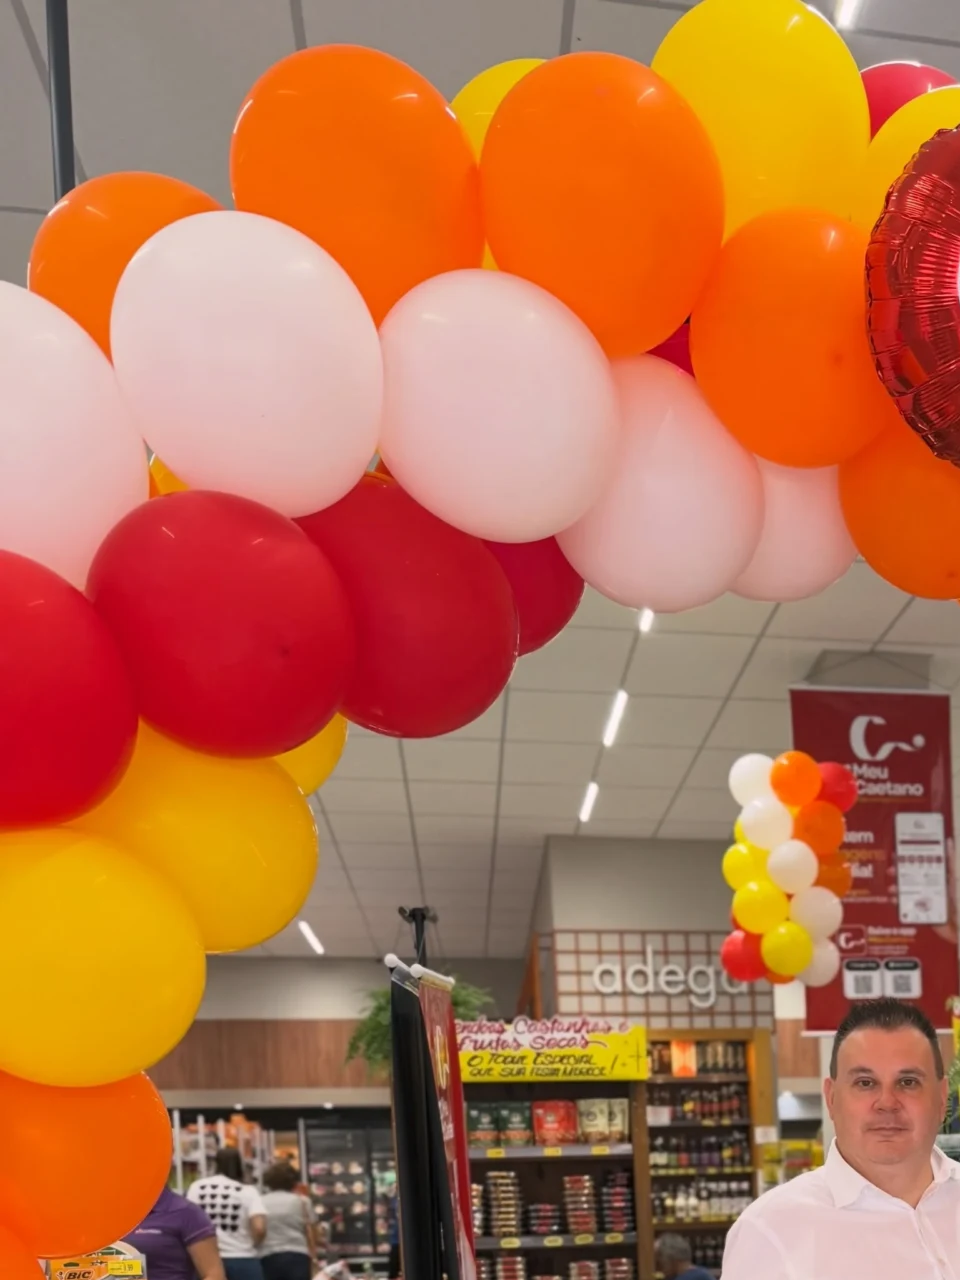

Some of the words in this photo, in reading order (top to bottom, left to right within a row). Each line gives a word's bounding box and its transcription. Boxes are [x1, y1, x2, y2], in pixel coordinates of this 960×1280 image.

[852, 763, 889, 779] Meu
[856, 780, 924, 796] Caetano
[514, 1014, 613, 1034] Castanhas
[529, 1035, 601, 1050] Secas
[467, 1055, 483, 1067] O
[487, 1053, 528, 1065] TOQUE
[532, 1052, 597, 1065] ESPECIAL
[469, 1066, 494, 1077] QUE
[500, 1066, 526, 1077] SUA
